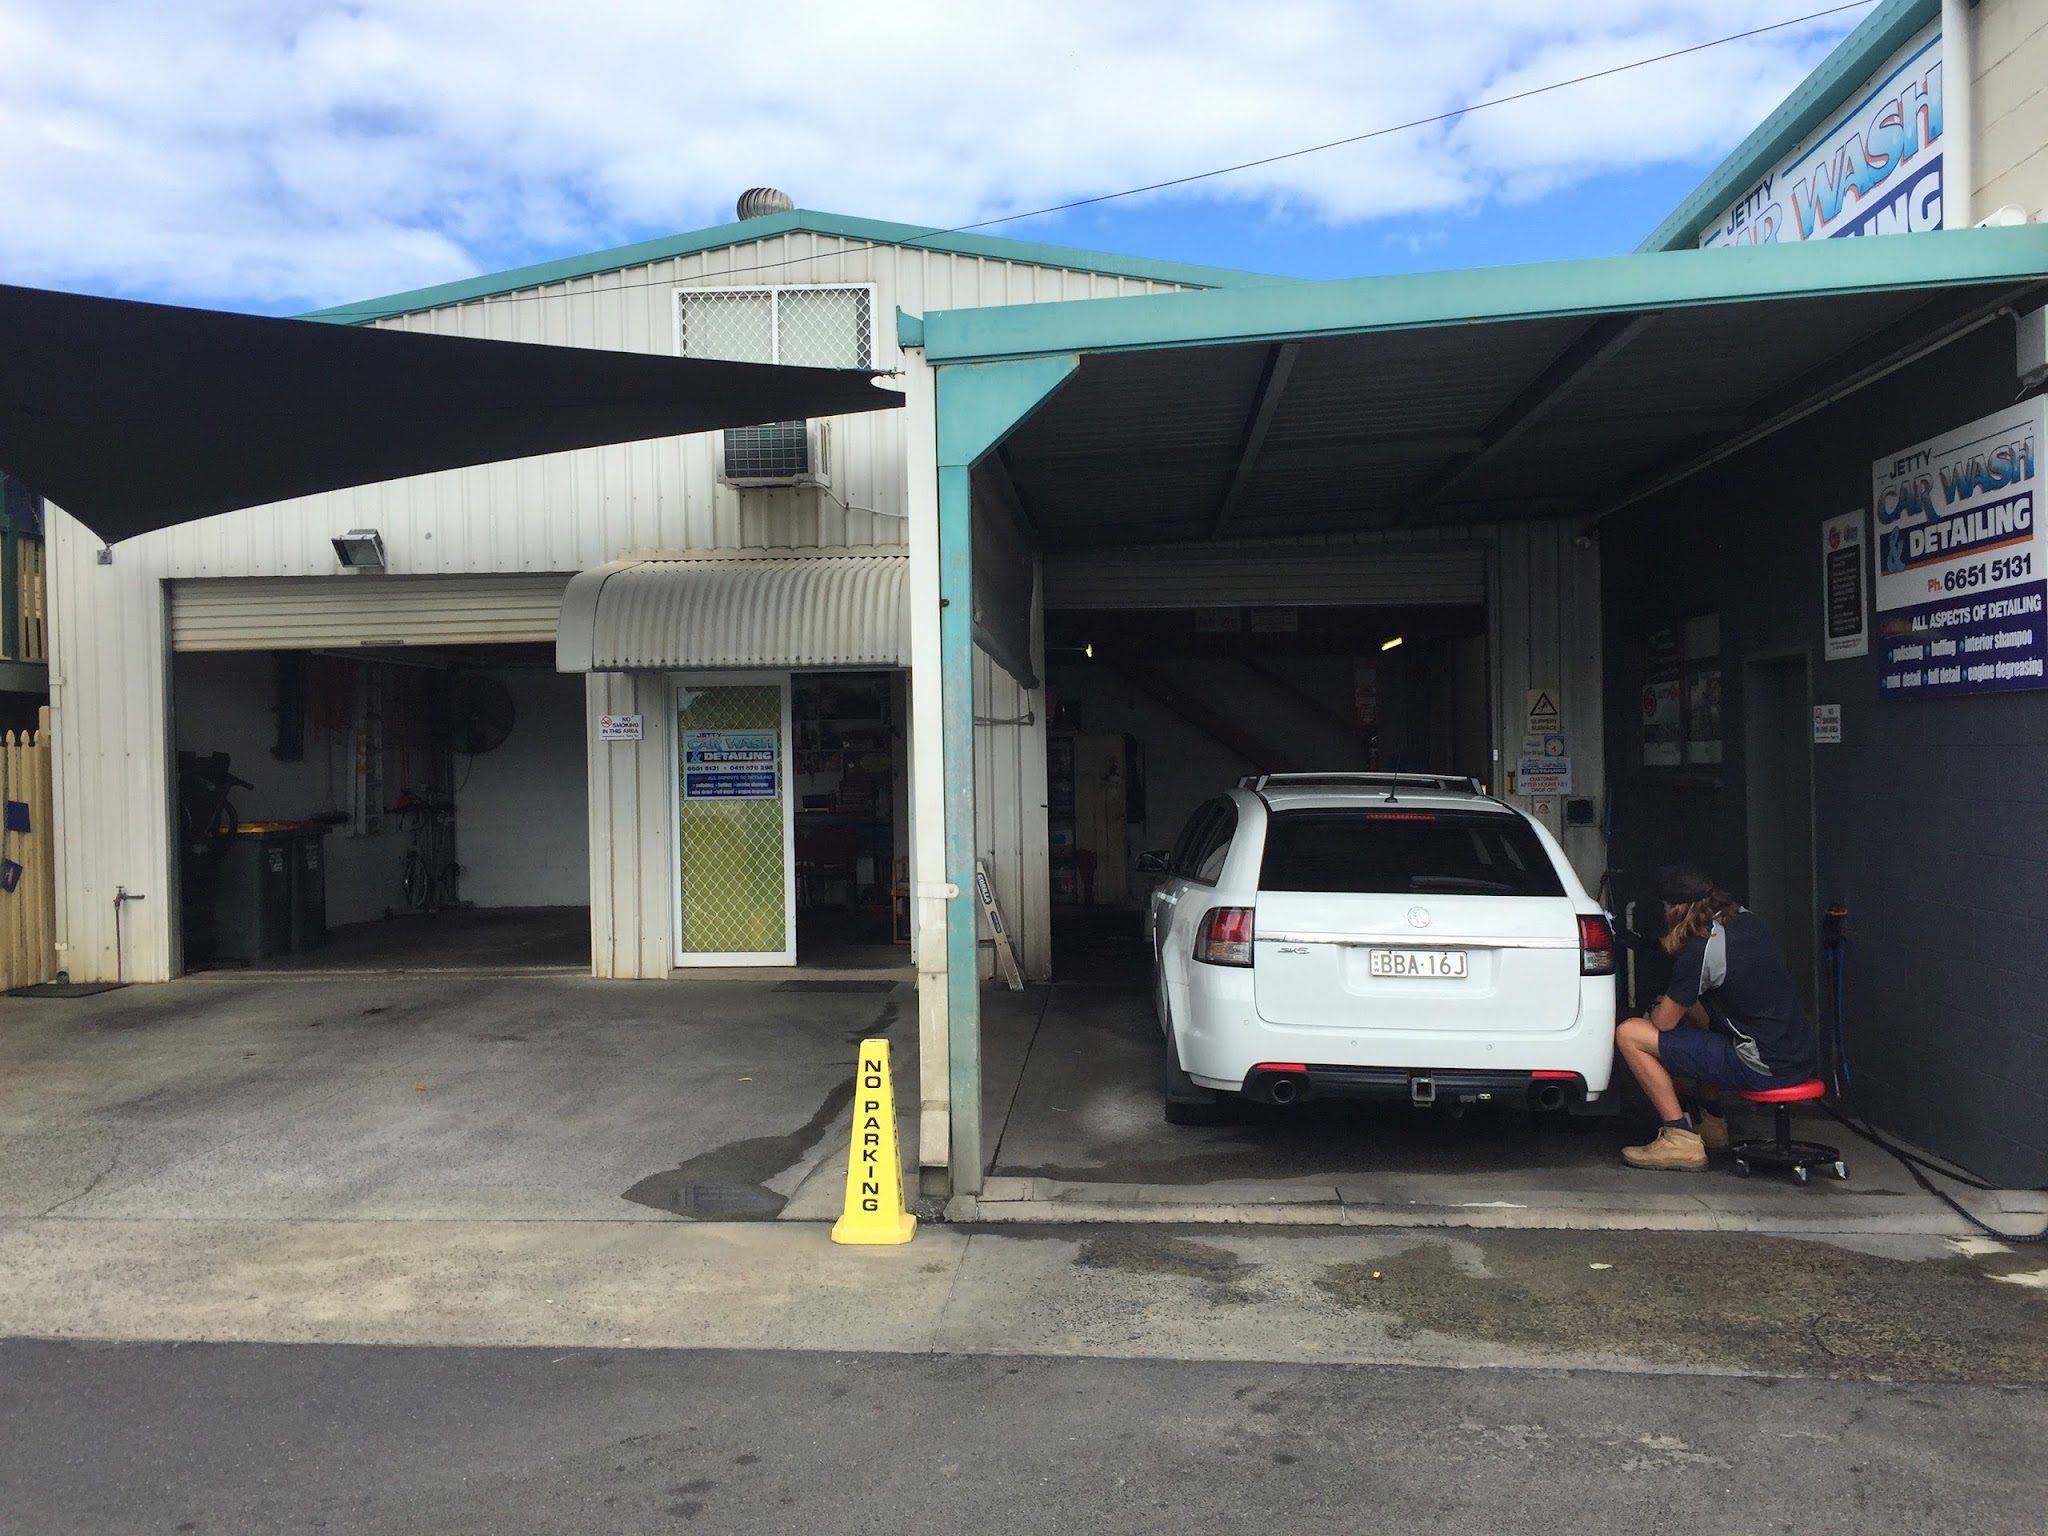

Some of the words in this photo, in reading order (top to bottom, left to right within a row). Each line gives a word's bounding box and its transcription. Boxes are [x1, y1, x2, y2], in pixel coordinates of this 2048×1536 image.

[1792, 61, 1943, 241] WASH
[1727, 174, 1774, 236] JETTY
[1877, 473, 1940, 526] CAR
[1941, 434, 2035, 504] WASH
[1889, 448, 1932, 480] JETTY
[1886, 526, 1906, 574] &
[1909, 497, 2031, 558] DETAILING
[1944, 563, 1987, 592] 6651
[1991, 552, 2032, 582] 5131
[1911, 615, 1929, 632] ALL
[1930, 608, 1971, 629] ASPECTS
[1972, 604, 1987, 621] OF
[1988, 593, 2042, 619] DETAILING
[1965, 632, 1994, 652] interior
[1994, 629, 2033, 649] shampoo
[1940, 665, 1961, 683] detail
[1967, 662, 1995, 682] engine
[1996, 657, 2044, 680] degreasing
[703, 752, 772, 760] DETAILING
[725, 737, 774, 749] WASH
[864, 1060, 881, 1089] NO
[862, 1101, 880, 1212] PARKING
